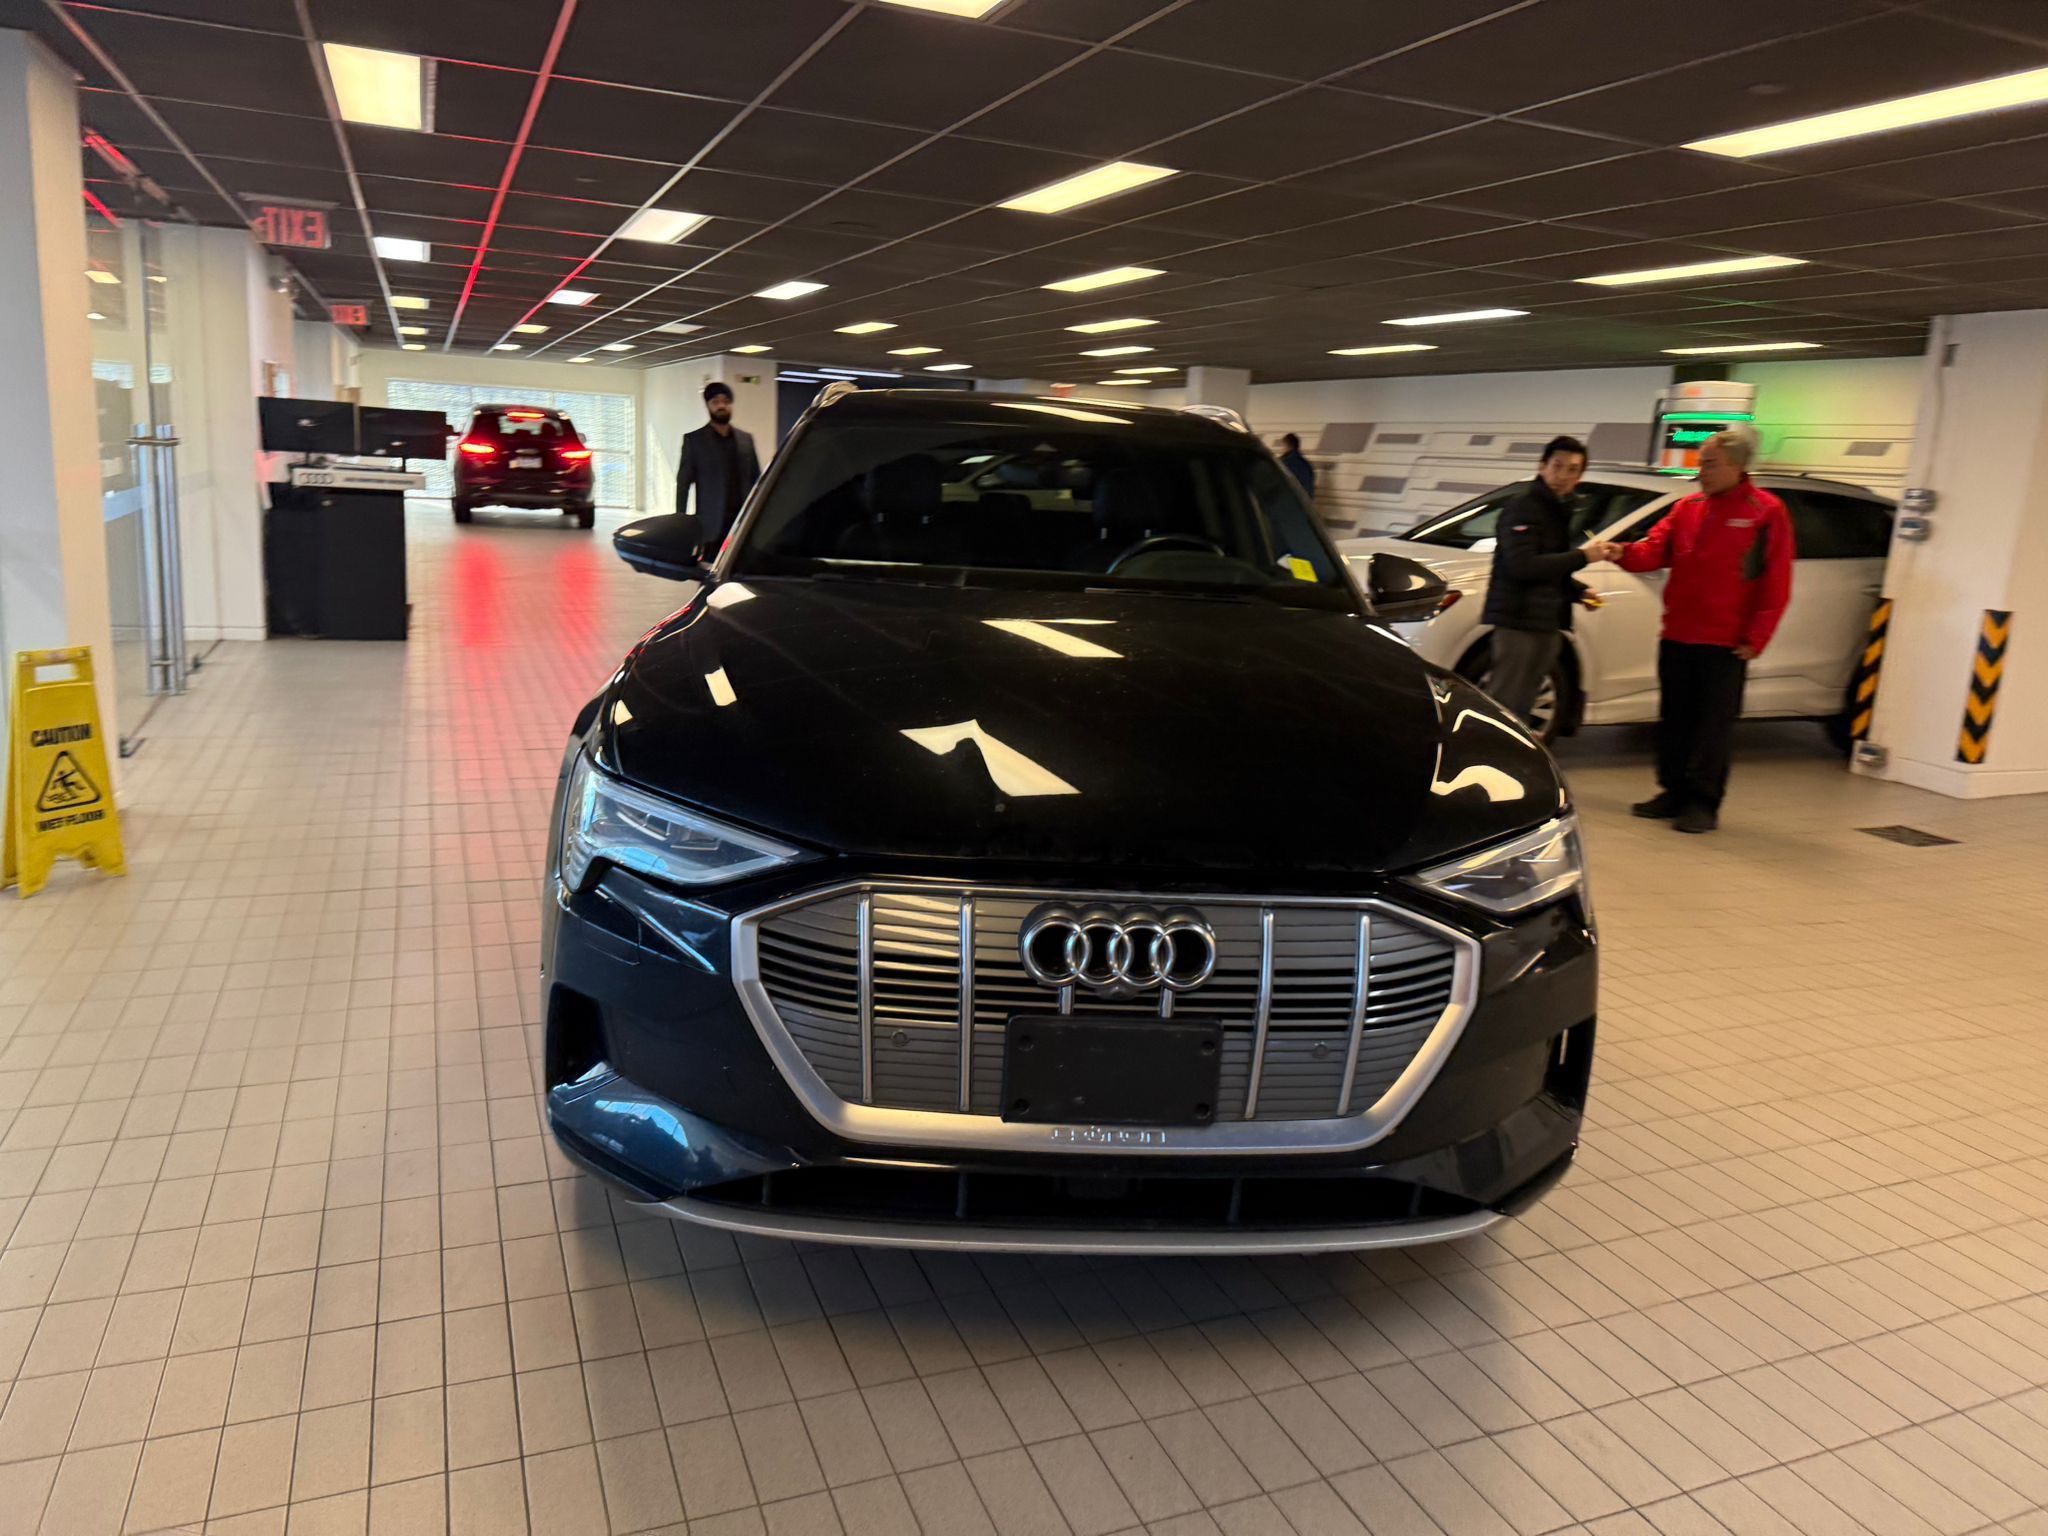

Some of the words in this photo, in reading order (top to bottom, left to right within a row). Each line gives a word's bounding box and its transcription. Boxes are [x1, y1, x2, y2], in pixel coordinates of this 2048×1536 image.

[31, 724, 91, 747] CAUTION
[37, 816, 65, 832] WET
[66, 809, 105, 825] FLOOR
